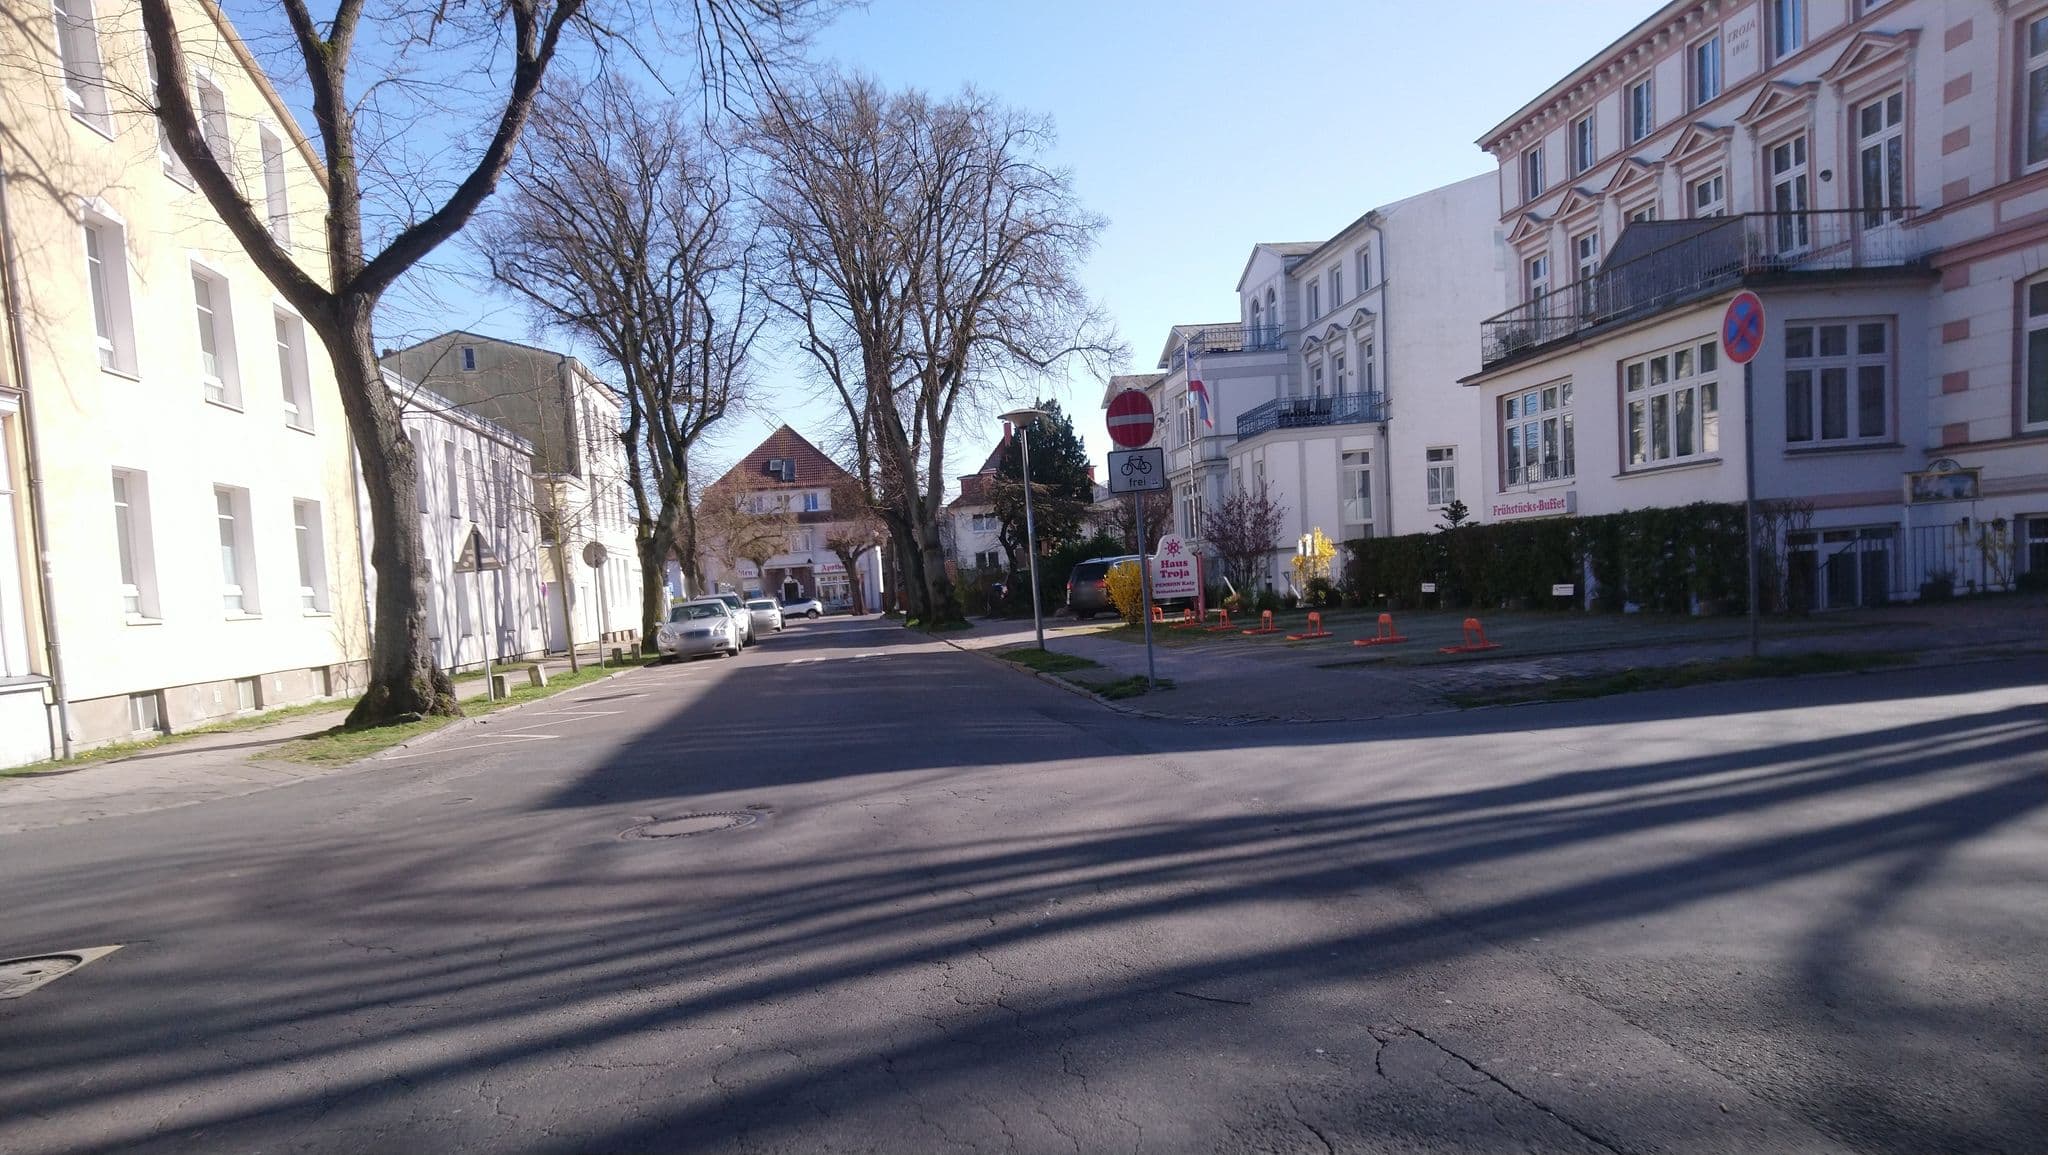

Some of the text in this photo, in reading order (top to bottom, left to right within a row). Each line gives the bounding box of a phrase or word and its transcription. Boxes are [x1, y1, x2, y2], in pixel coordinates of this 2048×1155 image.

[1129, 476, 1145, 487] frei
[1493, 498, 1565, 516] Frühstücks-Buffet
[1160, 560, 1188, 568] Haus
[1160, 569, 1189, 578] Troja
